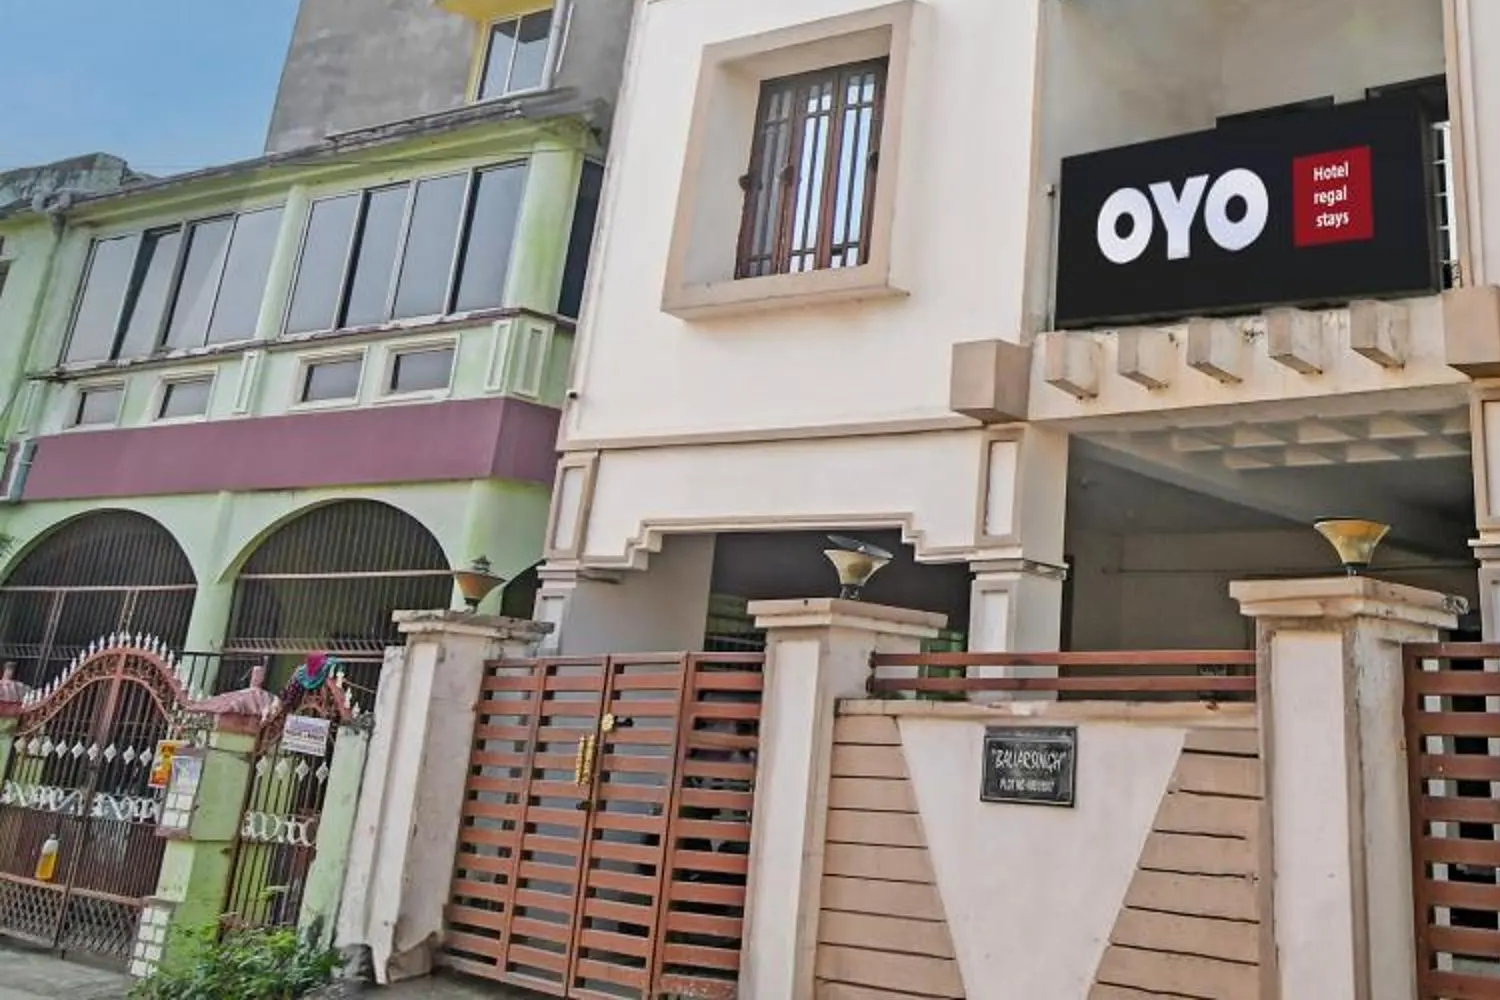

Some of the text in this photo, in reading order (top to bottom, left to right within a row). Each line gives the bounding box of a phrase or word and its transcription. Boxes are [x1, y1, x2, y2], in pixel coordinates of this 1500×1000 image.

[1313, 161, 1349, 181] Hotel
[1313, 184, 1347, 207] regal
[1097, 168, 1269, 264] OYO
[1316, 211, 1349, 229] stays
